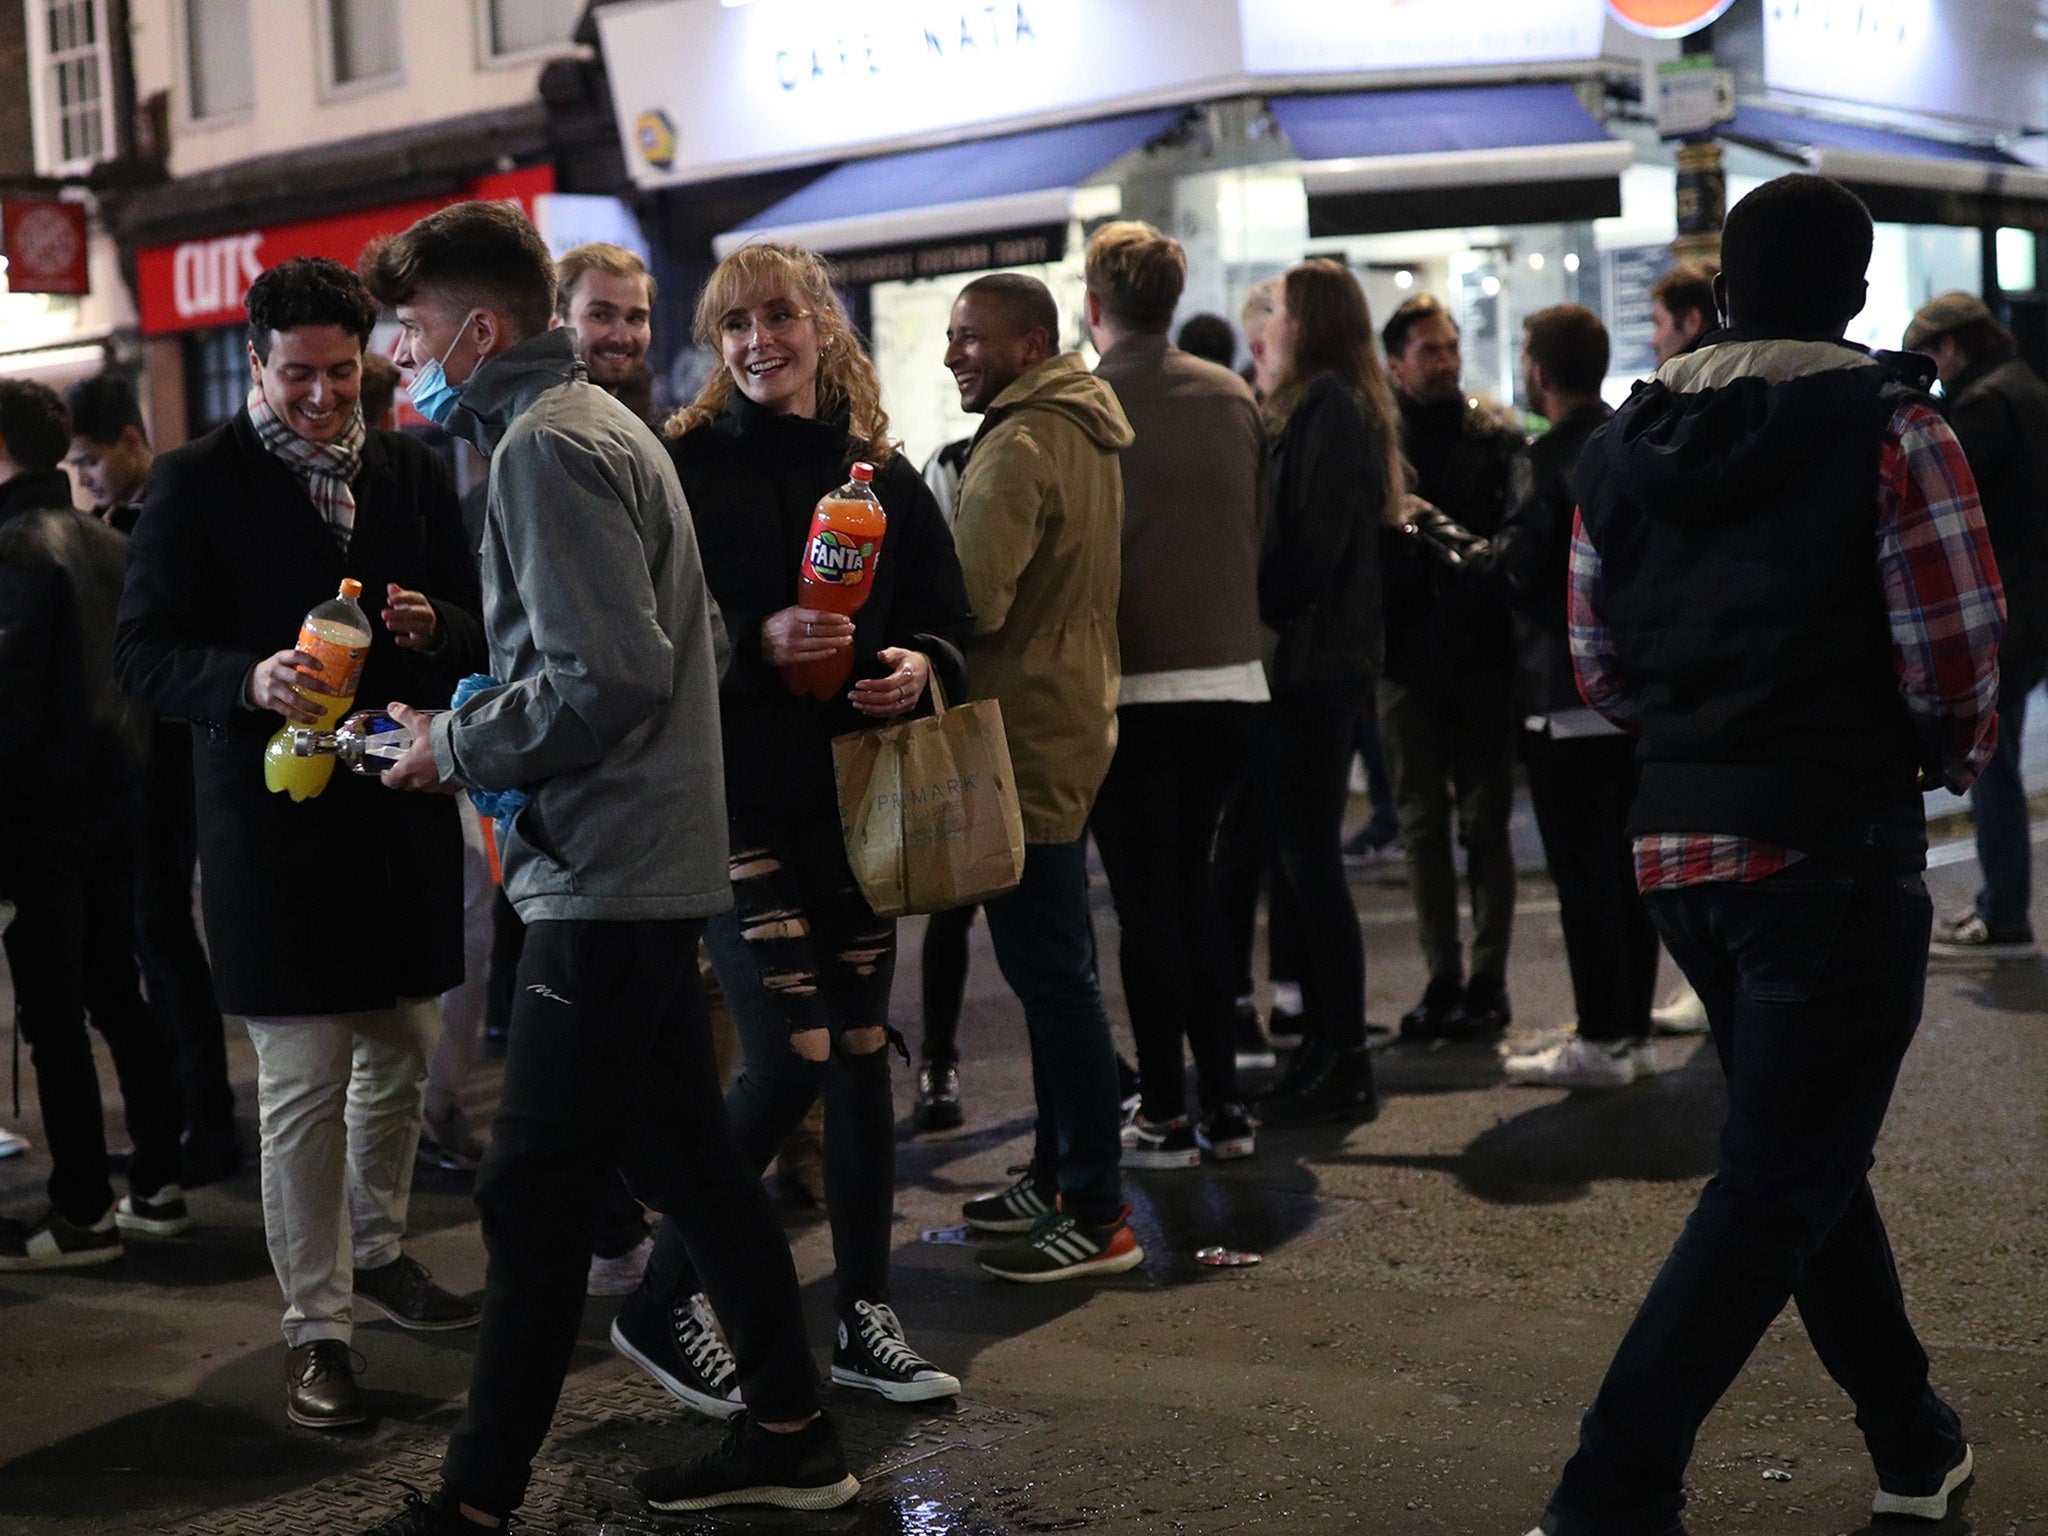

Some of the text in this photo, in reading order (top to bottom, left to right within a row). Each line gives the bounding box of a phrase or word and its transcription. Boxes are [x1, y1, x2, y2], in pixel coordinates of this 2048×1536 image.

[922, 2, 1037, 57] NATA
[173, 231, 265, 318] CUTS
[810, 536, 863, 570] FANTA
